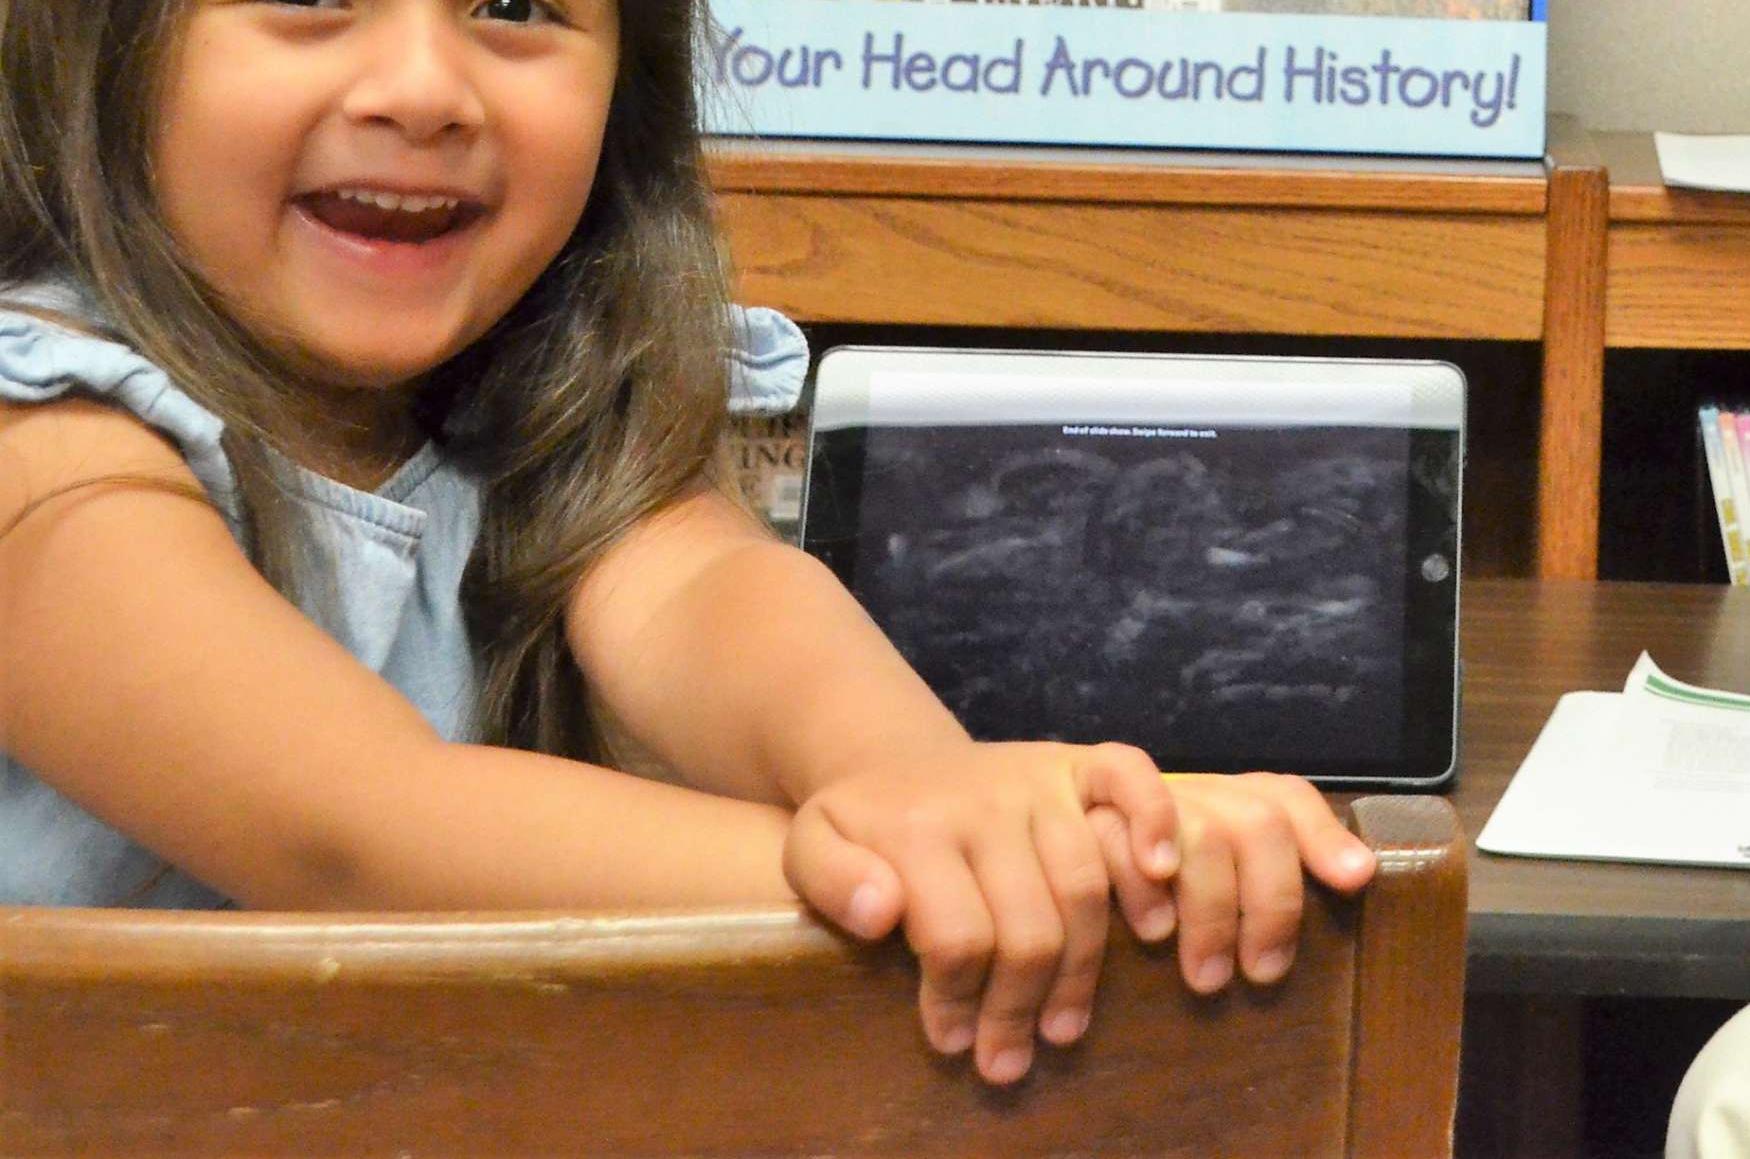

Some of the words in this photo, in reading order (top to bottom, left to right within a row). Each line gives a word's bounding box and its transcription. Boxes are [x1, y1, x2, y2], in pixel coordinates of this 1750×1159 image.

[710, 26, 843, 88] Your
[863, 31, 1024, 93] Head
[1040, 36, 1269, 101] Around
[1283, 44, 1521, 128] History!
[1062, 425, 1078, 435] End
